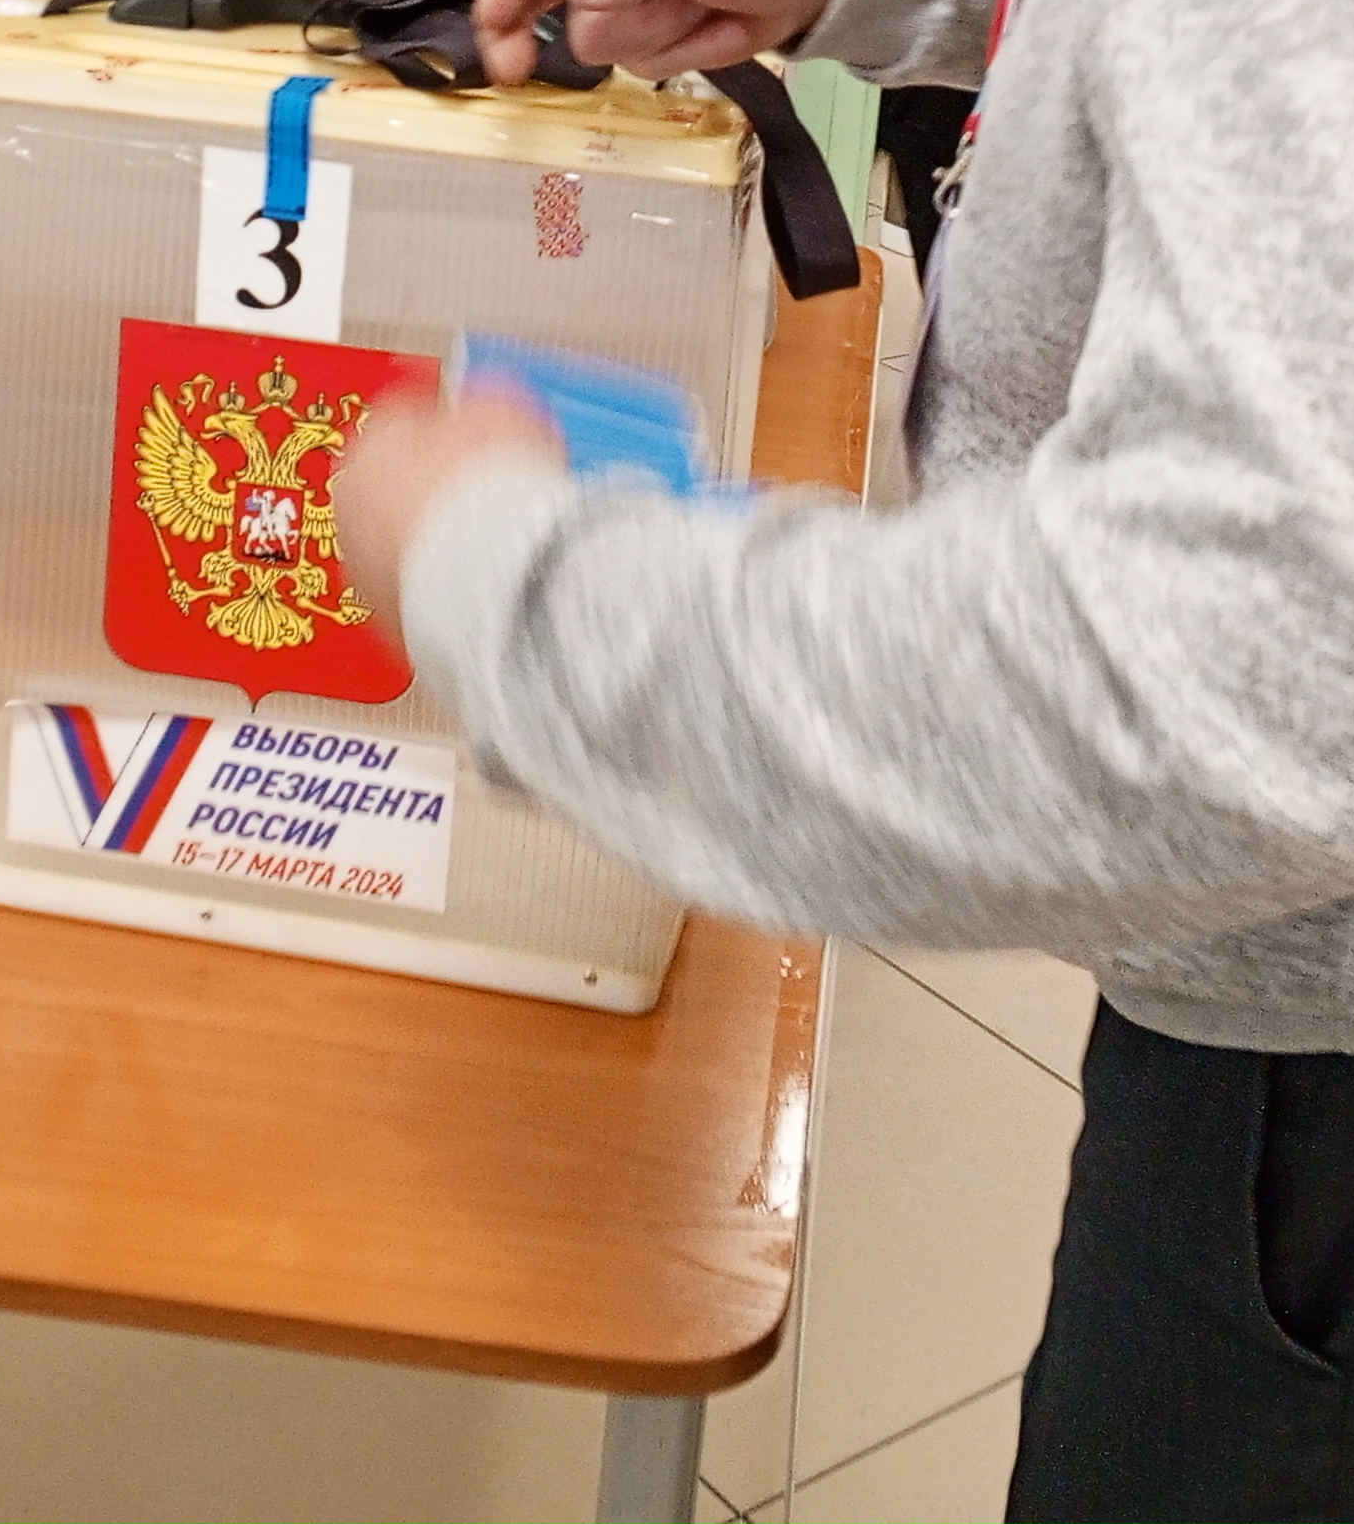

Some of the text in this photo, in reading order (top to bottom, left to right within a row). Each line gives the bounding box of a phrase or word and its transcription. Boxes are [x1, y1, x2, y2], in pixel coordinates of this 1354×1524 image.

[236, 207, 302, 309] 3
[231, 723, 399, 772] ВЫБОРЫ
[208, 762, 446, 825] ПРЕЗИДЕНТА
[186, 803, 340, 851] РОССИИ
[246, 854, 335, 890] МАРТА
[340, 867, 404, 899] 2024
